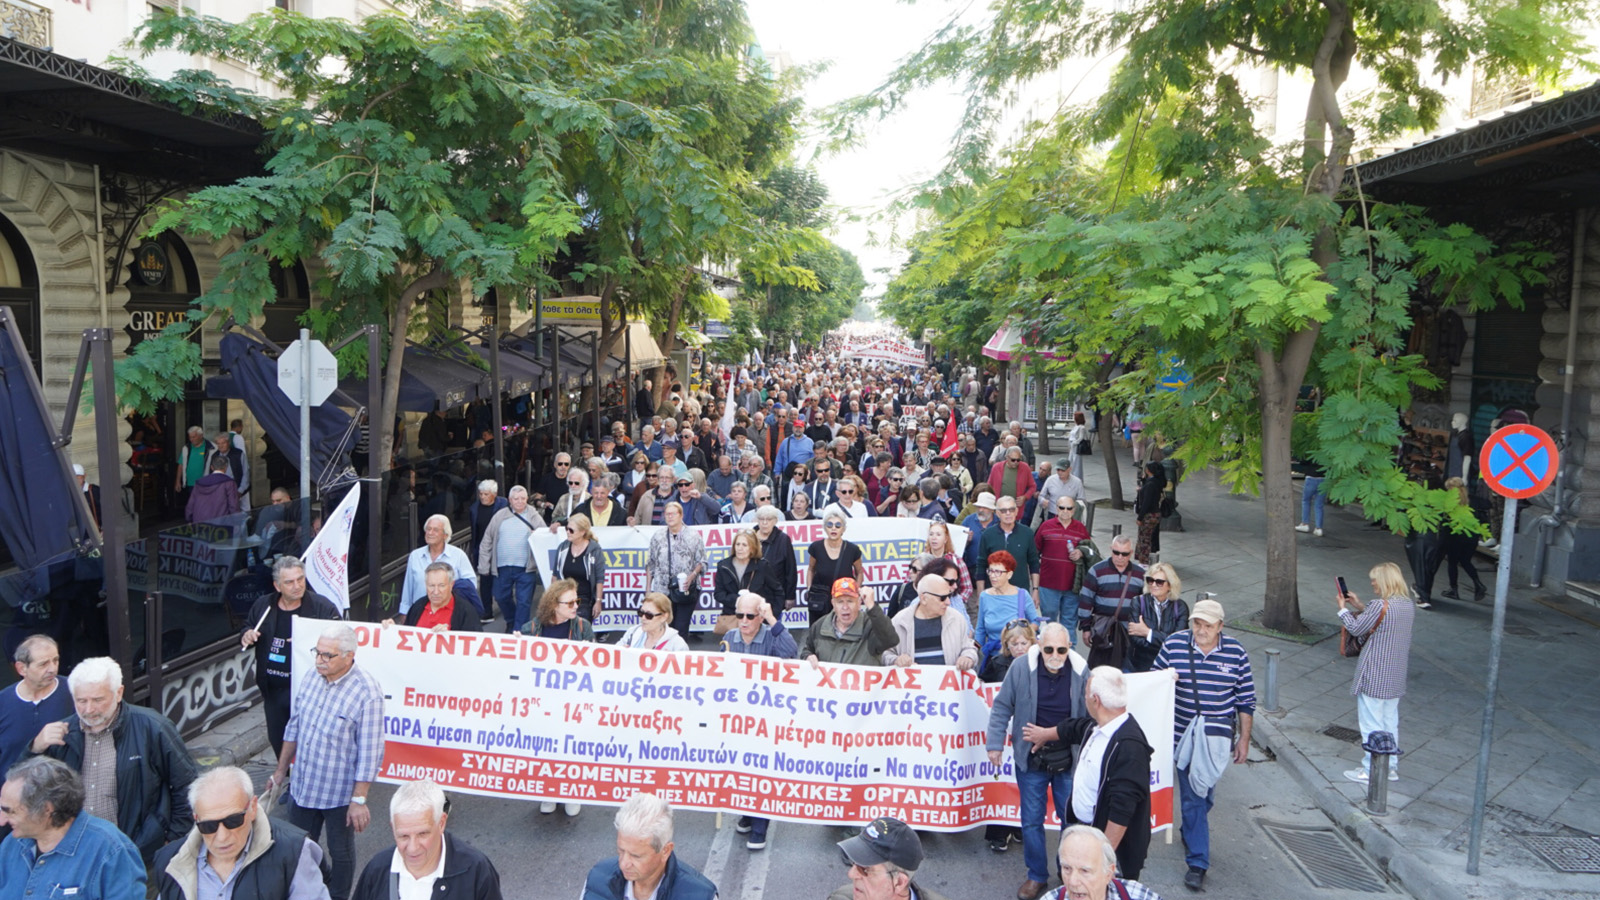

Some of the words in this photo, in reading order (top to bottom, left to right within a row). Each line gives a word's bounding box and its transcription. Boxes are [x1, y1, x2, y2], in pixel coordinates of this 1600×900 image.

[353, 626, 382, 648] ΟΙ
[396, 630, 622, 670] ΣΥΝΤΑΞΙΟΥΧΟΙ
[638, 651, 725, 678] ΟΛΗΣ
[740, 658, 801, 685] ΤΗΣ
[816, 665, 922, 692] ΧΩΡΑΣ
[403, 686, 504, 719] Επαναφορά
[597, 704, 683, 735] Σύνταξης
[719, 713, 769, 738] ΤΩΡΑ
[774, 719, 827, 748] μέτρα
[831, 723, 934, 753] προστασίας
[938, 733, 965, 755] για
[531, 667, 594, 693] ΤΩΡΑ
[601, 676, 706, 707] αυξήσεις
[712, 687, 739, 703] σε
[746, 682, 798, 716] όλες
[805, 696, 838, 720] τις
[845, 691, 960, 722] συντάξεις
[427, 717, 472, 746] άμεση
[476, 724, 558, 757] πρόσληψη:
[563, 734, 633, 764] Γιατρών,
[638, 739, 739, 765] Νοσηλευτών
[742, 751, 769, 770] στα
[773, 751, 869, 782] Νοσοκομεία
[885, 757, 908, 778] Να
[912, 757, 977, 787] ανοίξουν
[461, 752, 657, 785] ΣΥΝΕΡΓΑΖΟΜΕΝΕΣ
[666, 770, 853, 803] ΣΥΝΤΑΞΙΟΥΧΙΚΕΣ
[863, 785, 985, 808] ΟΡΓΑΝΩΣΕΙΣ
[386, 763, 456, 784] ΔΗΜΟΣΙΟΥ
[468, 773, 504, 790] ΠΟΣΕ
[507, 778, 545, 794] ΟΑΕΕ
[559, 782, 597, 799] ΕΛΤΑ
[686, 790, 717, 805] ΝΑΤ
[730, 793, 758, 810] ΠΣΣ
[760, 798, 845, 819] ΔΙΚΗΓΟΡΩΝ
[859, 804, 908, 822] ΠΟΣΕΑ
[911, 808, 959, 825] ΕΤΕΑΠ
